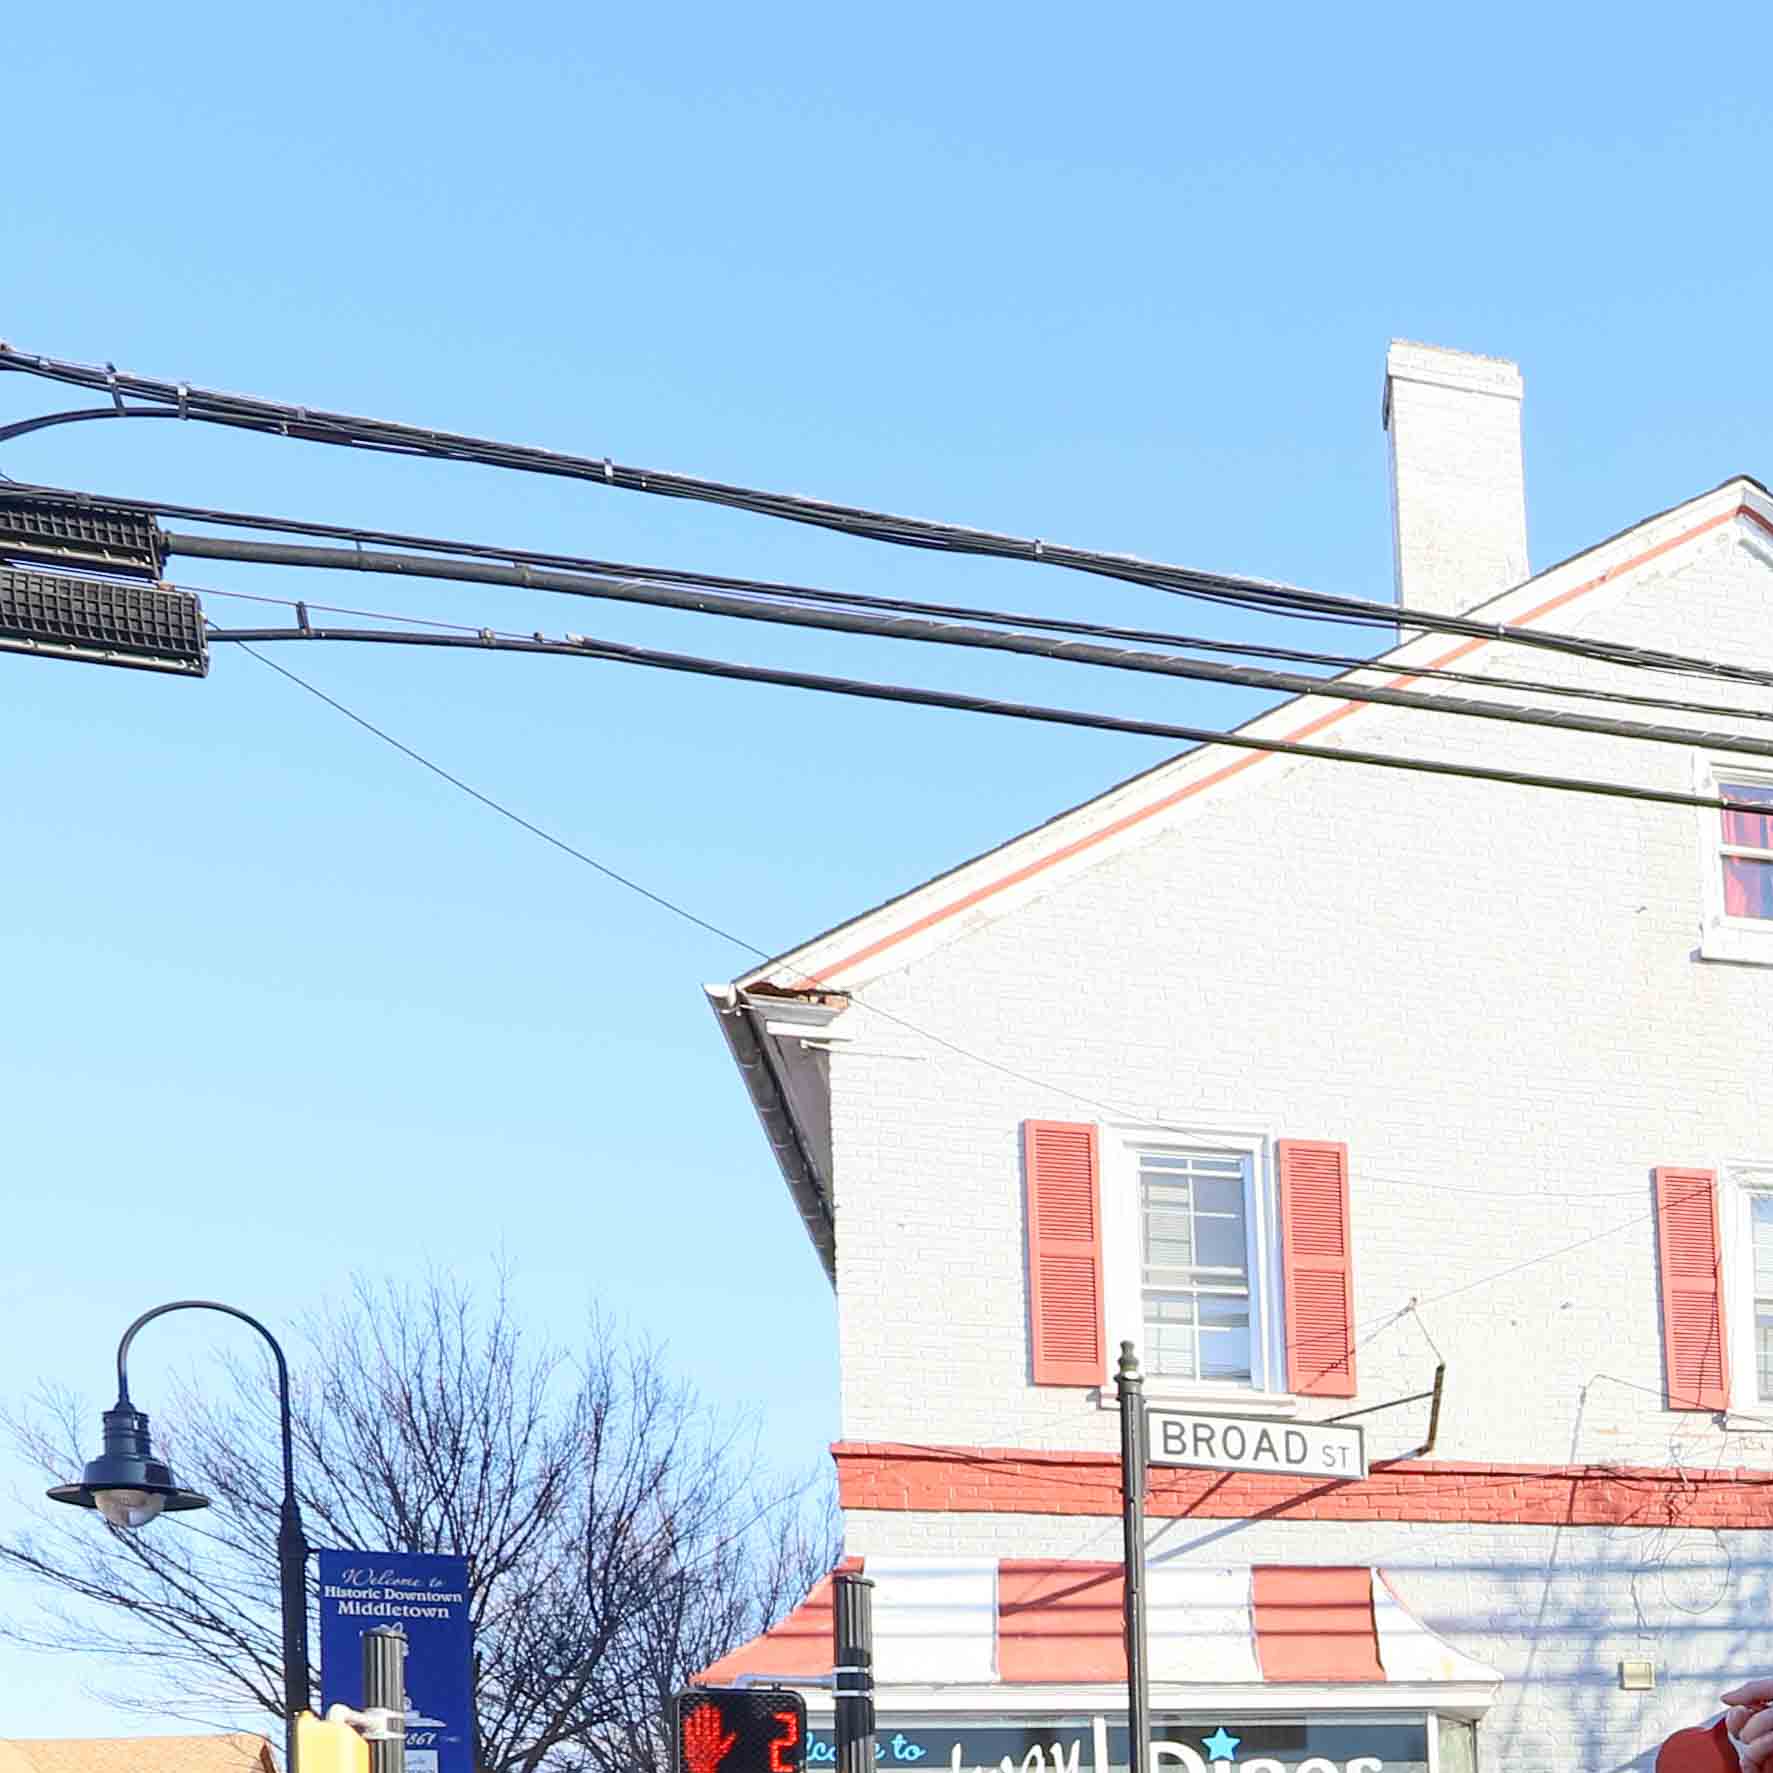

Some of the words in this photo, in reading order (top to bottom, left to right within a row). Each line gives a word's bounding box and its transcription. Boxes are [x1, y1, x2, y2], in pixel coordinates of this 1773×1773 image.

[1161, 1420, 1308, 1465] BROAD
[1322, 1445, 1350, 1469] ST
[342, 1568, 421, 1588] Welcome
[428, 1577, 445, 1588] to
[325, 1585, 381, 1600] Historic
[384, 1588, 463, 1604] Downtown
[338, 1600, 450, 1619] Middletown
[768, 1711, 798, 1773] 2
[891, 1734, 927, 1760] to
